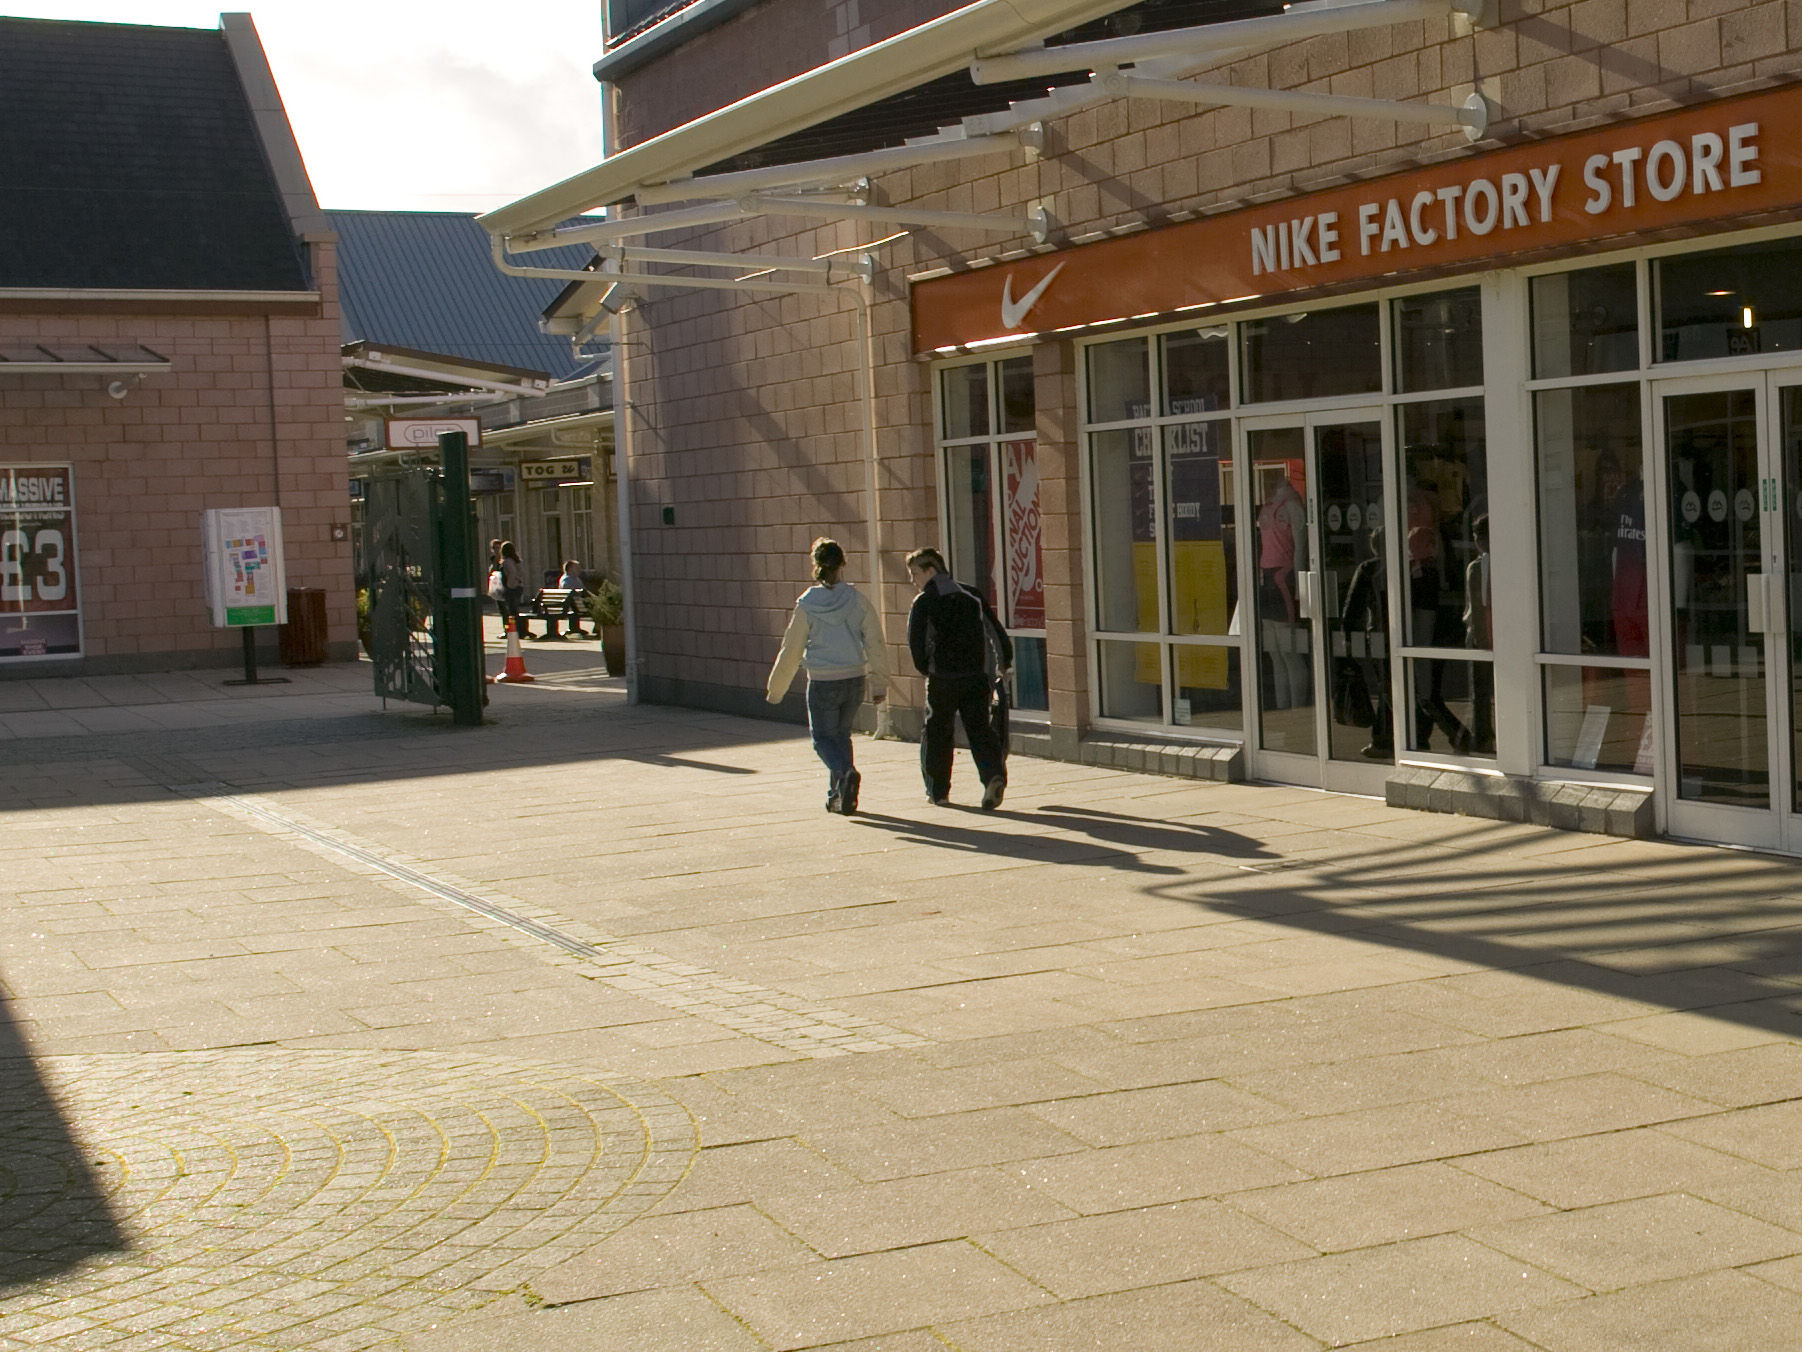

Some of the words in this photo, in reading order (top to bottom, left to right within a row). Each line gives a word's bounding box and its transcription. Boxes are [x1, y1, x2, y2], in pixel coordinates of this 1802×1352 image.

[1250, 211, 1341, 276] NIKE
[1359, 164, 1562, 256] FACTORY
[1583, 121, 1762, 215] STORE
[524, 465, 555, 476] TOG
[1620, 513, 1633, 527] Fly
[0, 529, 67, 601] £3
